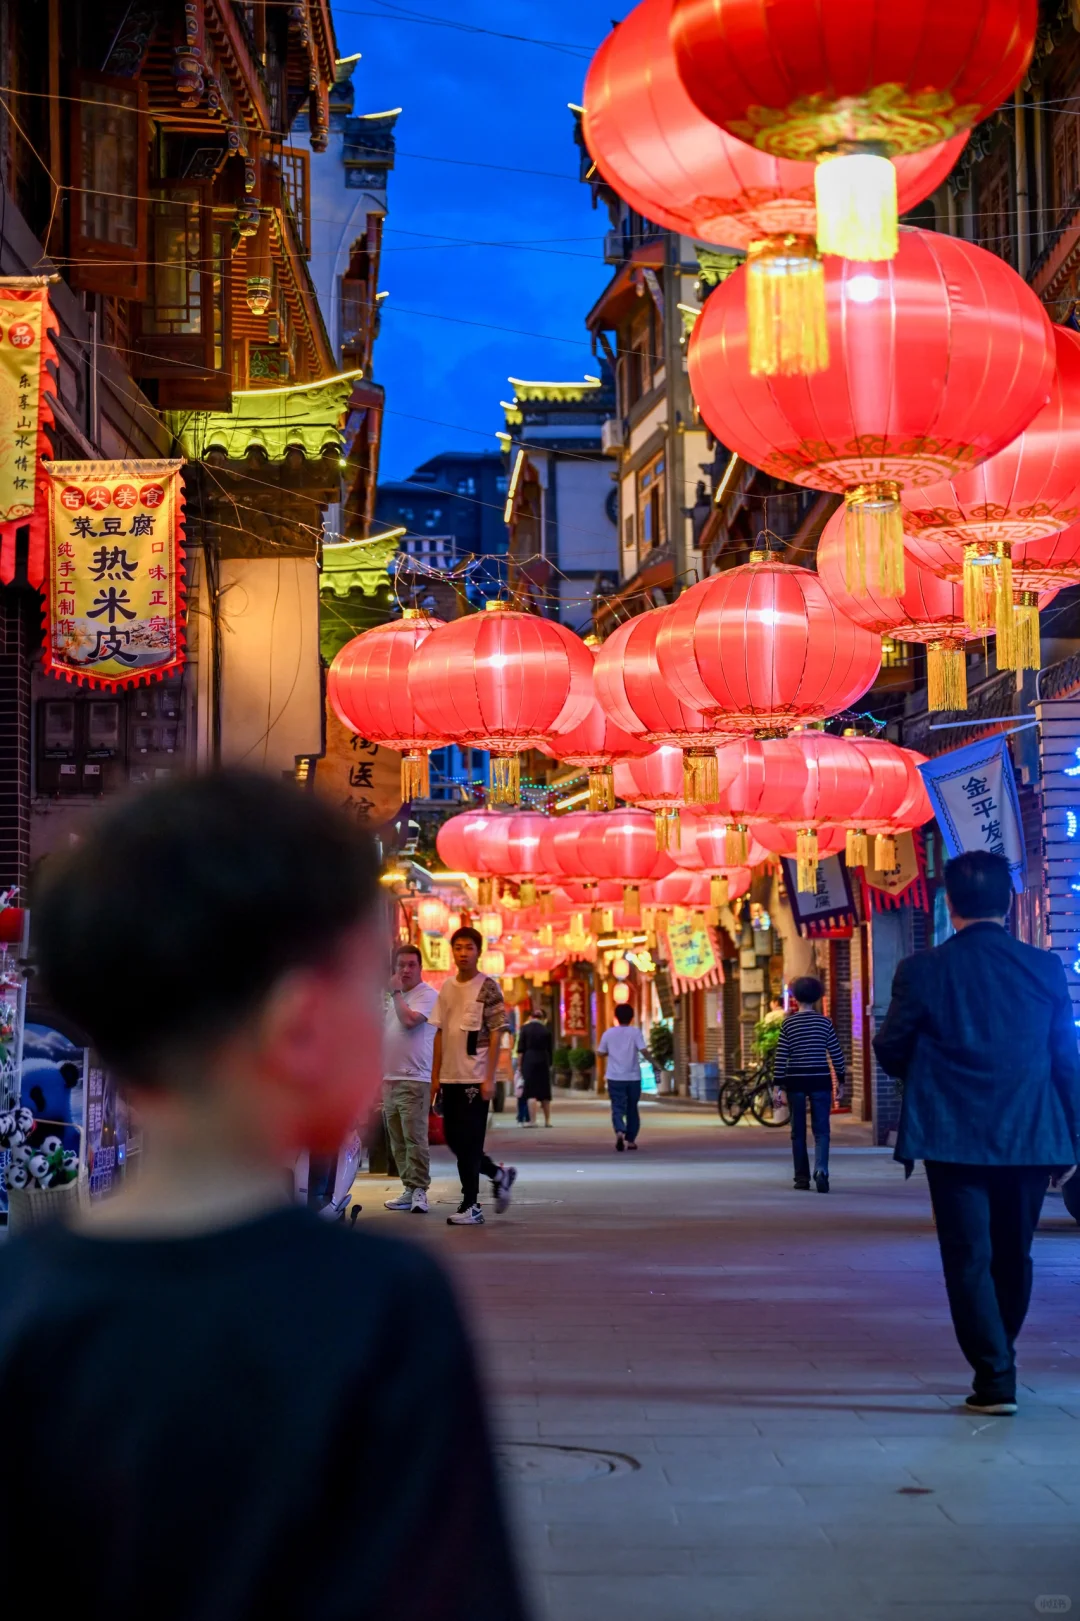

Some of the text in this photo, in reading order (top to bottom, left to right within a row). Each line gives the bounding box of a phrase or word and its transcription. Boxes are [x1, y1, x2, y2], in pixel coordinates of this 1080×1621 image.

[13, 373, 32, 491] 乐享山水情怀
[62, 485, 165, 509] 舌尖美食
[69, 513, 157, 539] 菜豆腐
[57, 541, 76, 635] 纯手工制作
[86, 545, 140, 663] 热米皮
[148, 541, 167, 632] 口味正宗
